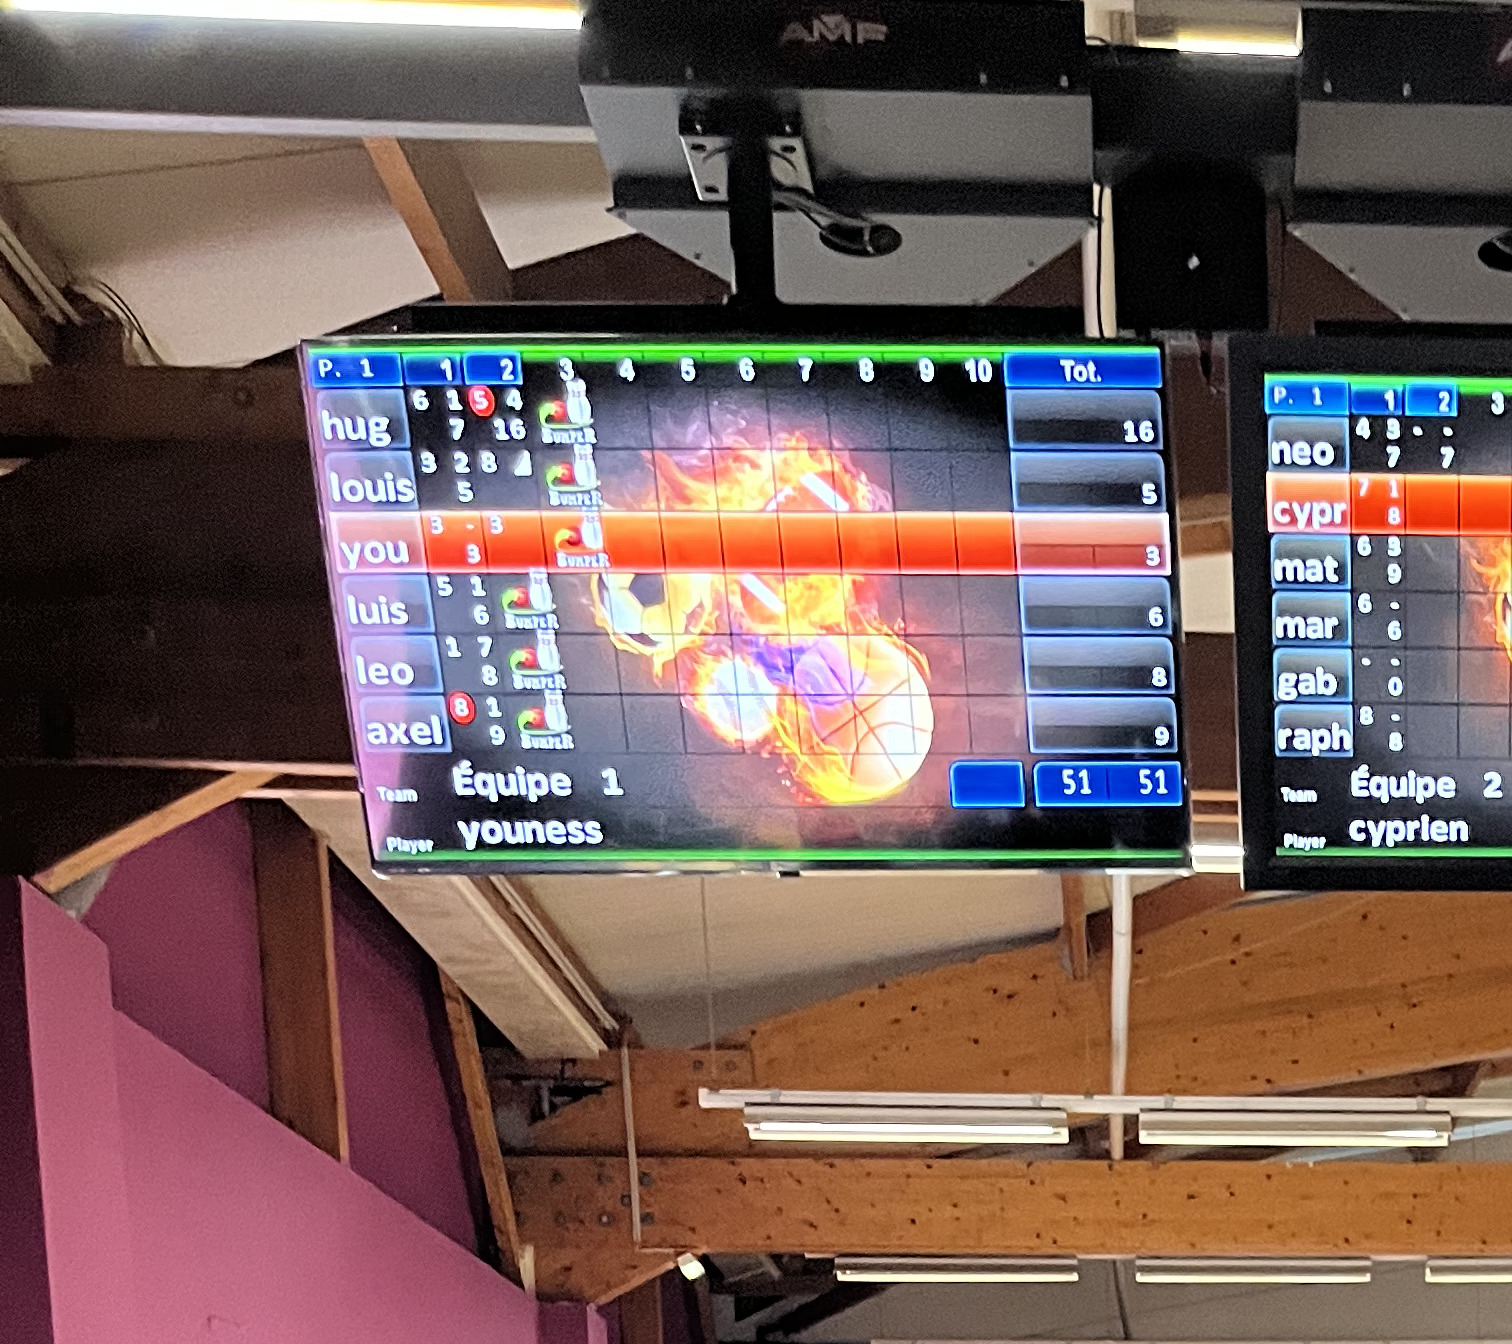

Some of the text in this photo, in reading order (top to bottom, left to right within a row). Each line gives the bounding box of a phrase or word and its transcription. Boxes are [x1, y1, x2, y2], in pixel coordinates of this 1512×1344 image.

[361, 359, 374, 377] 1
[441, 361, 453, 380] 1
[500, 359, 514, 380] 2
[559, 359, 575, 380] 3
[618, 359, 635, 381] 4
[680, 359, 696, 382] 5
[739, 359, 755, 382] 6
[798, 359, 813, 382] 7
[859, 359, 875, 382] 8
[918, 359, 935, 383] 9
[964, 359, 992, 383] 10
[1060, 360, 1102, 383] Tot.
[413, 390, 523, 410] 6 1 5 4
[1384, 389, 1395, 411] 1
[1438, 391, 1450, 412] 2
[1490, 392, 1505, 415] 3
[321, 411, 391, 447] hug
[450, 419, 464, 440] 7
[495, 419, 526, 440] 16
[1122, 421, 1154, 443] 16
[420, 452, 497, 473] 3 2 8
[1271, 439, 1335, 467] neo
[1386, 445, 1401, 468] 7
[1440, 445, 1455, 469] 7
[330, 472, 415, 503] louis
[458, 482, 474, 502] 5
[1141, 483, 1157, 505] 5
[1272, 498, 1347, 531] cypr
[1387, 506, 1401, 526] 8
[340, 540, 409, 570] you
[467, 544, 481, 564] 3
[1145, 546, 1160, 566] 3
[1357, 535, 1372, 557] 6
[1274, 554, 1339, 583] mat
[437, 575, 486, 597] 5 1
[349, 595, 408, 625] luis
[474, 605, 489, 625] 6
[1148, 606, 1164, 627] 6
[1357, 592, 1373, 615] 6
[1275, 612, 1339, 640] mar
[1387, 620, 1402, 641] 6
[446, 636, 493, 658] 1 7
[356, 656, 414, 686] leo
[482, 665, 498, 686] 8
[1151, 667, 1168, 688] 8
[1277, 665, 1338, 701] gab
[1387, 675, 1403, 696] 0
[454, 697, 502, 718] 8 1
[367, 715, 443, 745] axel
[489, 725, 506, 746] 9
[1153, 726, 1170, 747] 9
[1277, 722, 1351, 756] raph
[377, 760, 1169, 803] Team Équipe 1 51 51
[1350, 764, 1457, 803] Équipe
[1482, 771, 1503, 799] 2
[386, 817, 603, 854] Player youness
